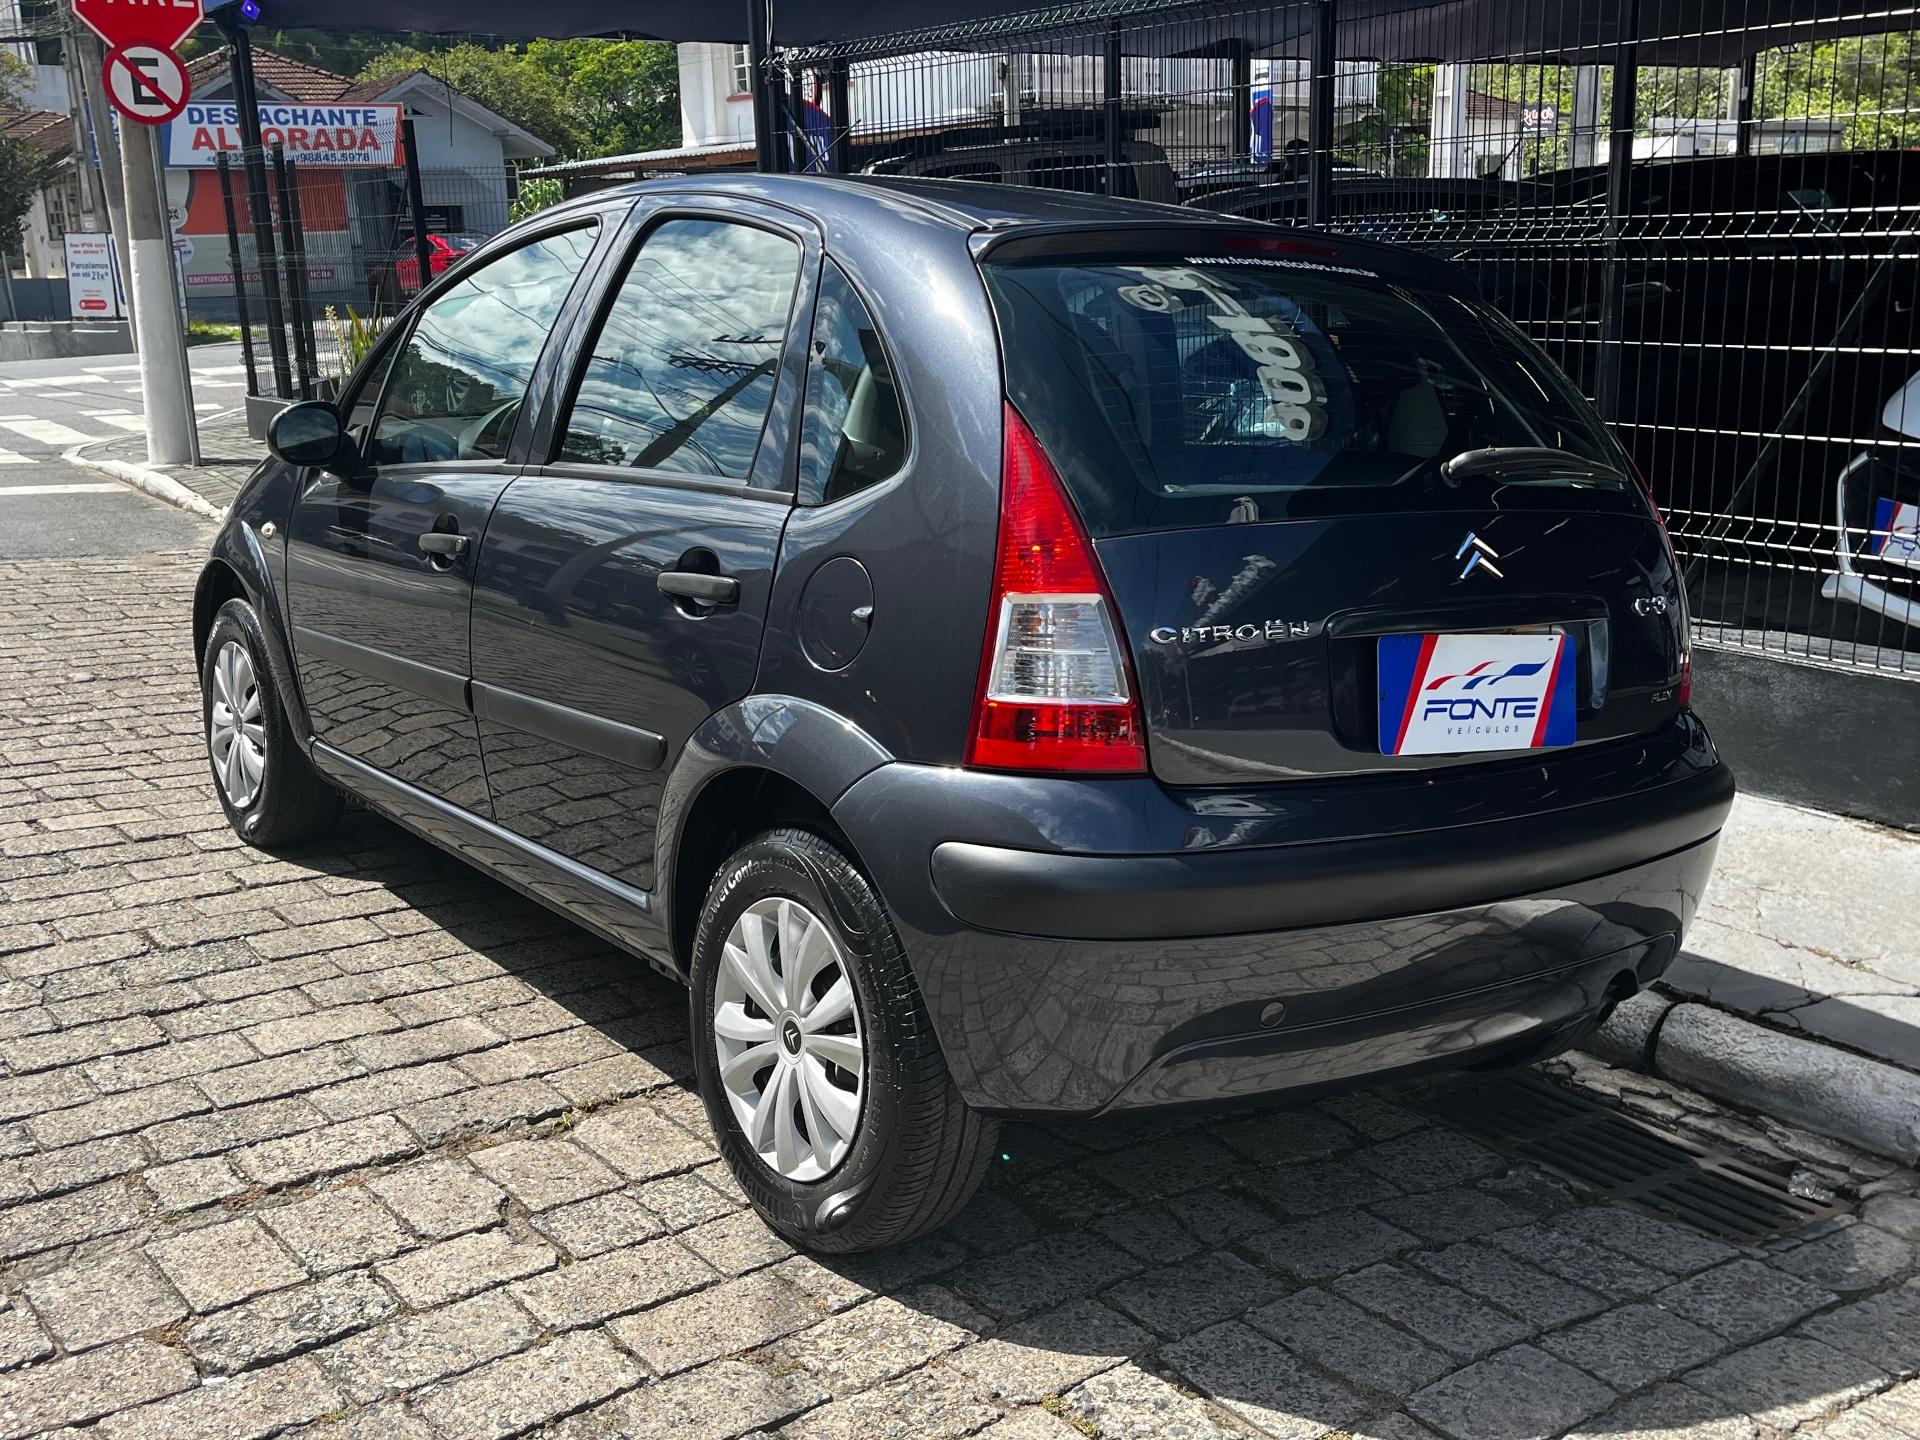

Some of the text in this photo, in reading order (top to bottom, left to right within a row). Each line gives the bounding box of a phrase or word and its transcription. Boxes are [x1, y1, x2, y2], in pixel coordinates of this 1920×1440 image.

[187, 107, 378, 126] DESACHANTE
[189, 274, 228, 284] EMITIMOS
[1632, 594, 1667, 617] C3
[1150, 619, 1311, 645] CITROËN
[1651, 689, 1673, 704] FLEX
[1423, 697, 1539, 721] FONTE
[1447, 725, 1520, 736] VEÍCULOS
